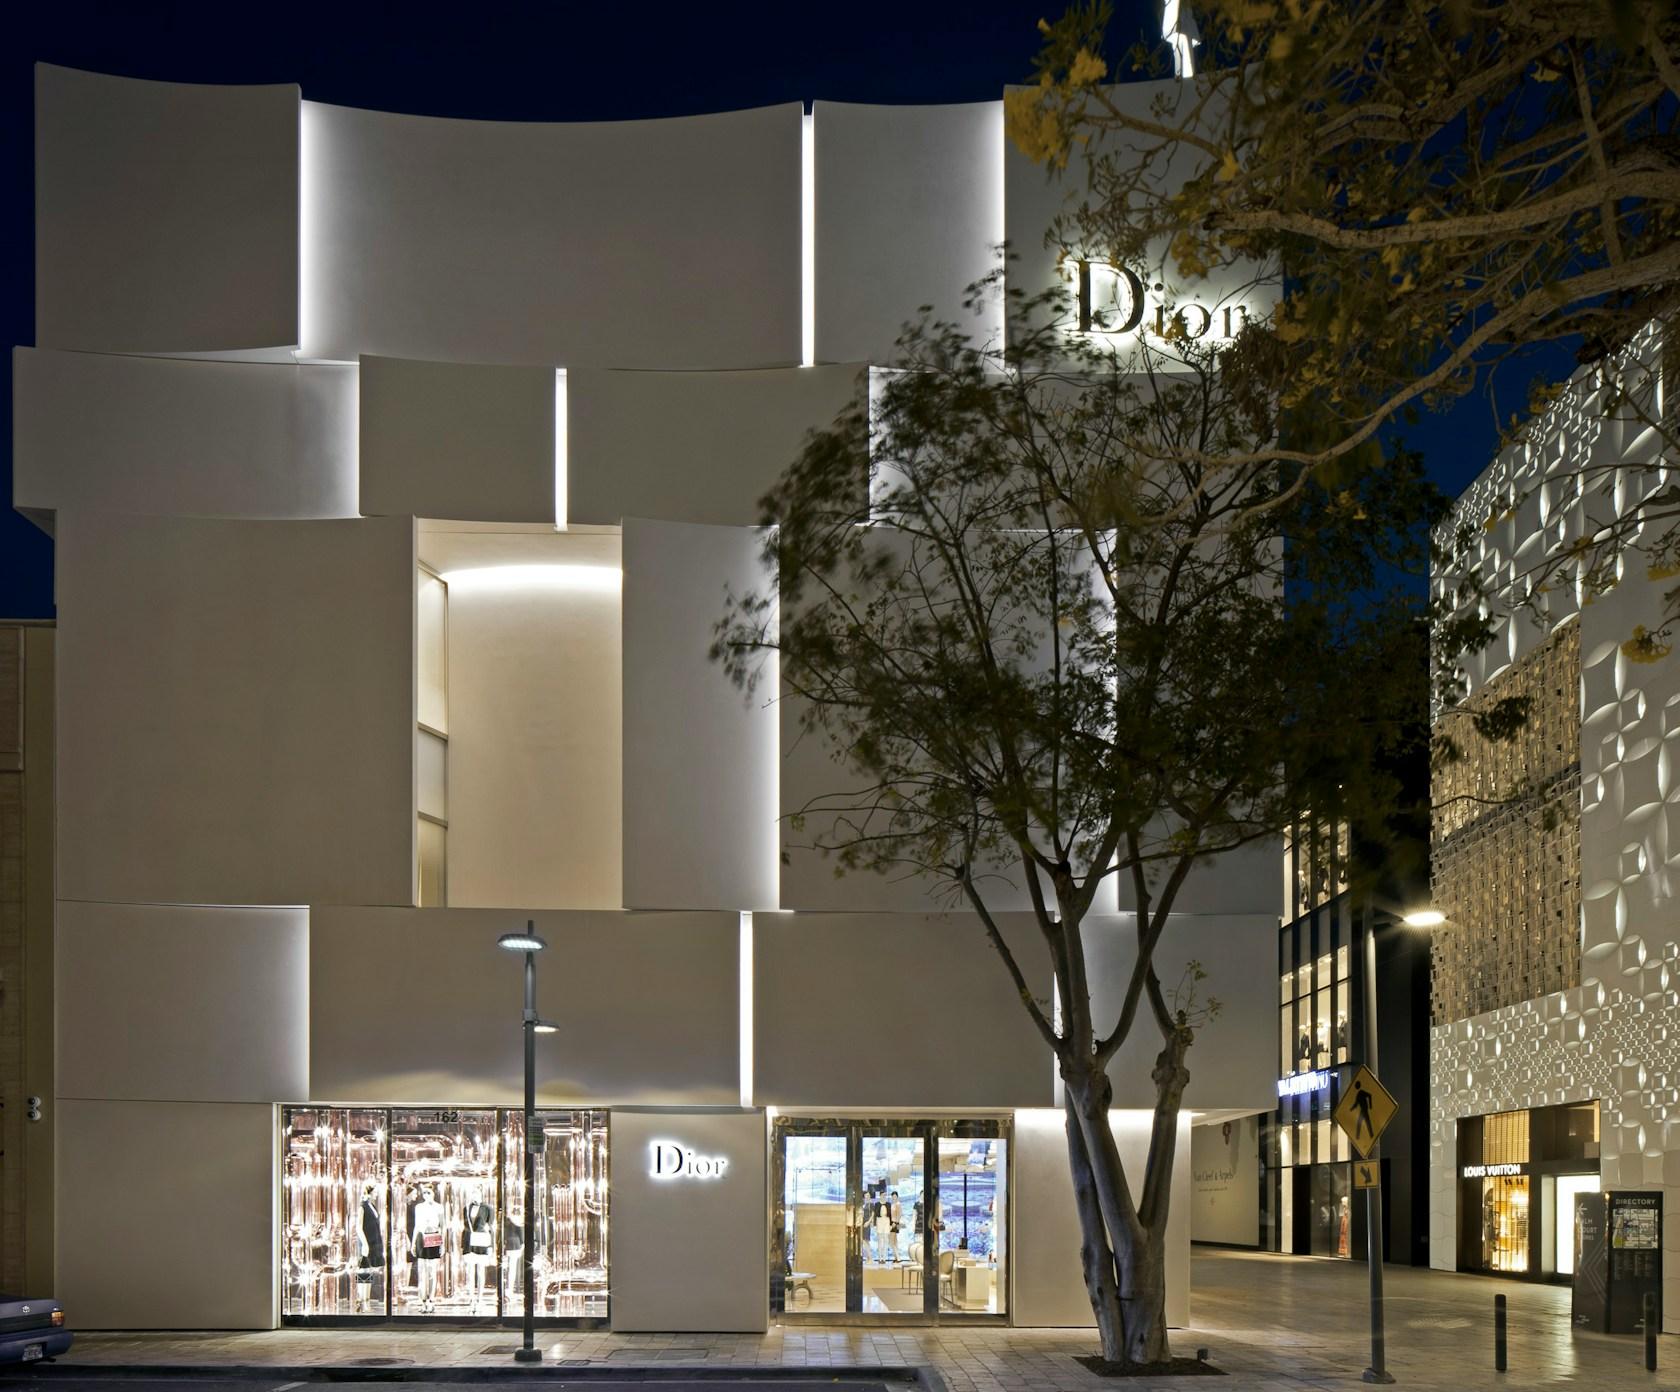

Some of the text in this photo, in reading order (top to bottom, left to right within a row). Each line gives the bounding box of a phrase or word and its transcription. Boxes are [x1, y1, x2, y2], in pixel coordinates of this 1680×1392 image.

[1063, 259, 1247, 339] Dior
[434, 1111, 458, 1123] 162
[653, 1144, 726, 1176] Dior
[1464, 1164, 1521, 1178] LOUIS VUITTON
[1615, 1198, 1656, 1206] DIRECTORY
